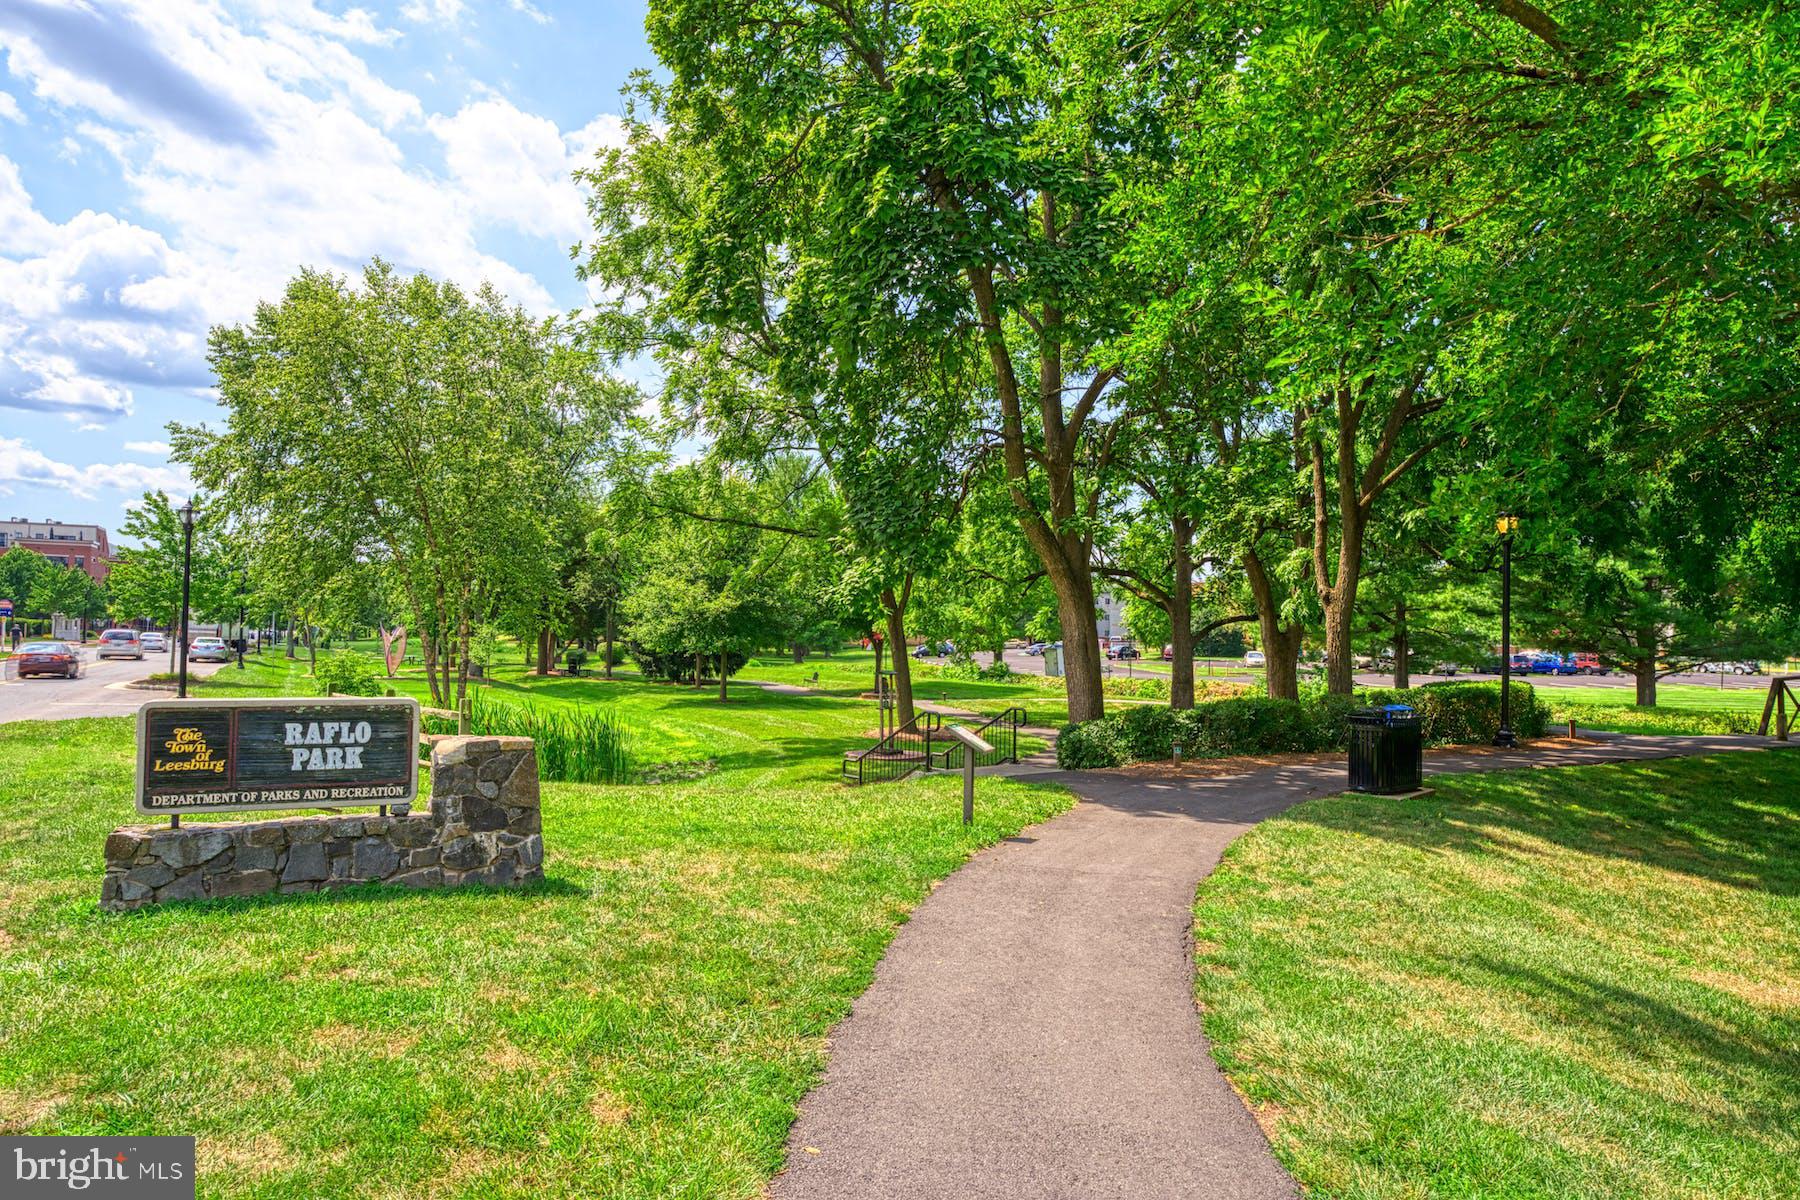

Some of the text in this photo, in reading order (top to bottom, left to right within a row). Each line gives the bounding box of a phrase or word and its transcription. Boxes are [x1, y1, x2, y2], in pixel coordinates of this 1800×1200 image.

[174, 727, 202, 743] The
[284, 721, 372, 746] RAFLO
[165, 740, 207, 754] Town
[195, 748, 214, 763] of
[291, 746, 364, 771] PARK
[154, 759, 226, 774] Leesburg
[151, 785, 404, 807] DEPARTMENT OF PARKS AND RECREATION
